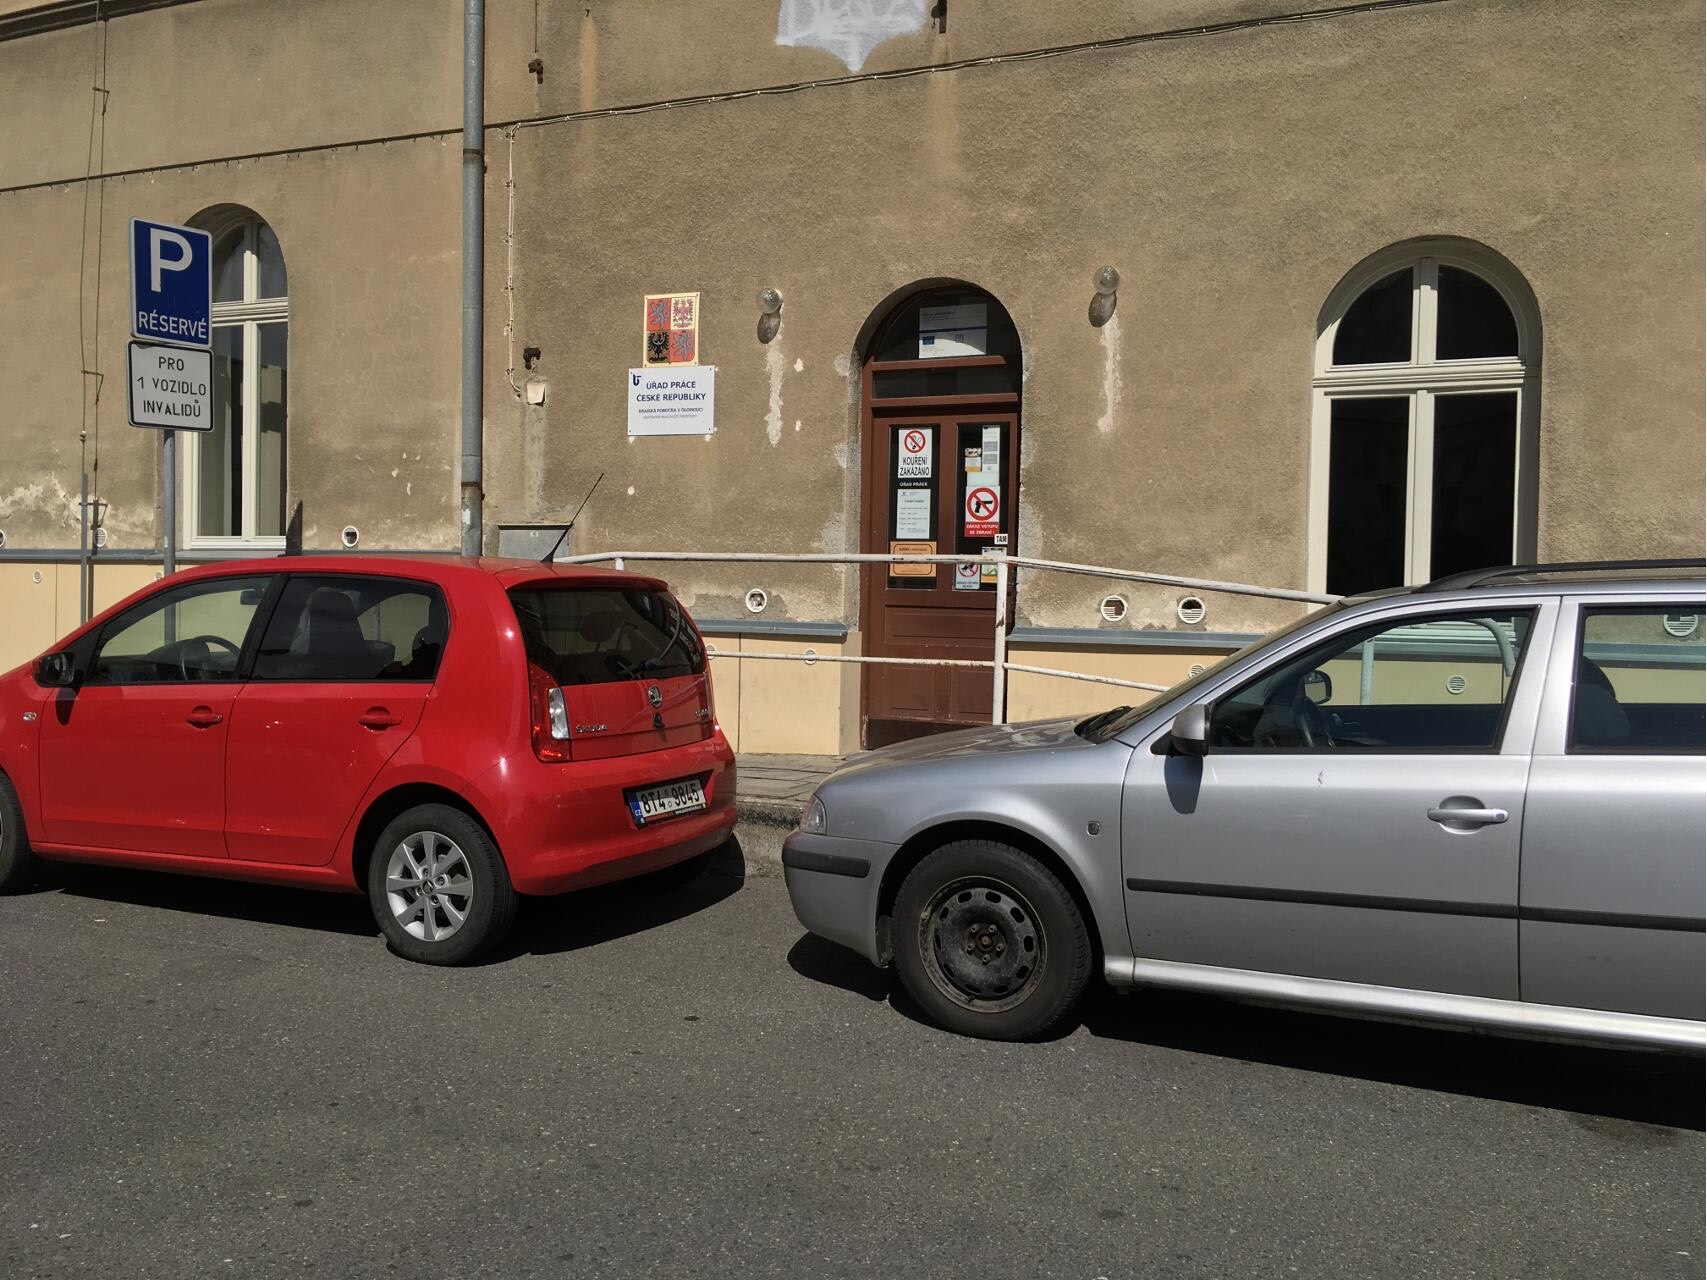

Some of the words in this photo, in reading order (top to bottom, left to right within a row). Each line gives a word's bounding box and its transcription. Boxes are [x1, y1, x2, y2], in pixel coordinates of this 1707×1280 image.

[150, 227, 193, 293] P
[138, 310, 208, 339] RÉSERVÉ
[158, 356, 185, 371] PRO
[136, 376, 145, 389] 1
[152, 378, 207, 395] VOZIDLO
[646, 381, 668, 390] ÚŘAD
[670, 380, 696, 389] PRÁCE
[663, 393, 706, 401] REPUBLIKY
[143, 399, 201, 417] INVALIDŮ
[902, 455, 928, 466] KOUŘENÍ
[996, 535, 1007, 543] TAM
[641, 790, 665, 814] 8T4
[671, 782, 699, 806] 9845
